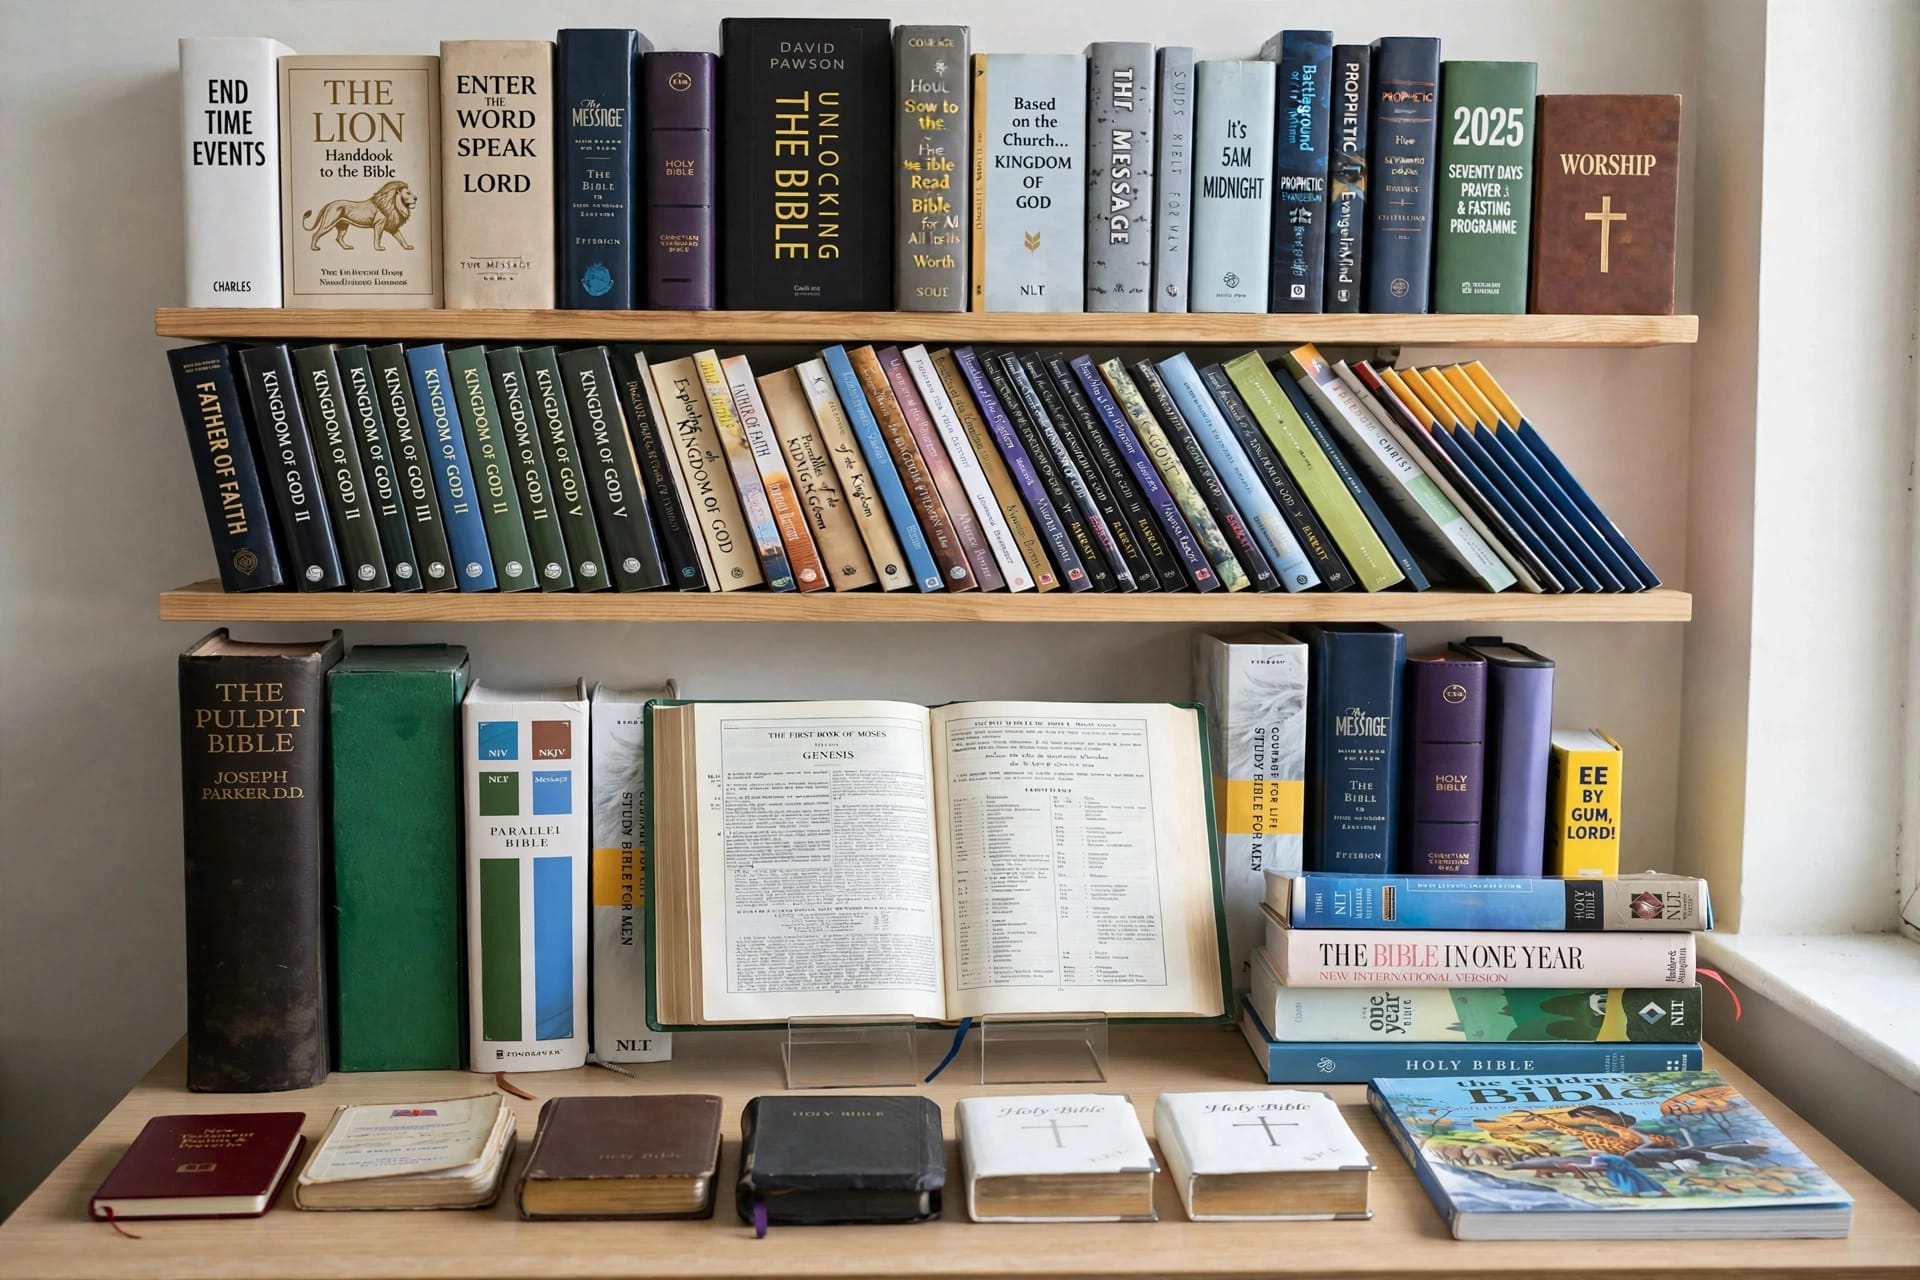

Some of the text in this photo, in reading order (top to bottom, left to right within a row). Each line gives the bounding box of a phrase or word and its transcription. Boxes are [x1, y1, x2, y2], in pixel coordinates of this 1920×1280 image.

[781, 42, 835, 54] DAVID
[770, 58, 845, 70] PAWSON
[208, 79, 248, 104] END
[323, 79, 394, 105] THE
[456, 75, 537, 96] ENTER
[484, 97, 506, 107] THE
[905, 99, 959, 113] Sow to
[1014, 97, 1056, 111] Based
[205, 110, 253, 135] TIME
[312, 112, 406, 143] LION
[456, 109, 536, 130] WORD
[775, 91, 809, 157] THE
[1012, 114, 1058, 128] on the
[1453, 106, 1524, 147] 2025
[1227, 120, 1247, 139] It's
[456, 138, 537, 158] SPEAK
[1003, 133, 1069, 147] Church...
[193, 141, 266, 166] EVENTS
[994, 156, 1072, 169] KINGDOM
[1221, 147, 1251, 167] 5AM
[320, 165, 396, 178] to the Bible
[665, 160, 695, 168] HOLY
[666, 168, 695, 176] BIBLE
[1449, 165, 1523, 180] SEVENTY DAYS
[1560, 154, 1656, 176] WORSHIP
[463, 173, 531, 193] LORD
[586, 170, 611, 179] THE
[818, 92, 840, 259] UNLOCKING
[911, 174, 950, 190] Read
[1022, 176, 1044, 189] OF
[1281, 176, 1323, 191] PROPHETIC
[1109, 129, 1133, 245] MESSAGE
[1203, 177, 1265, 199] MIDNIGHT
[1461, 183, 1501, 198] PRAYER
[912, 196, 952, 213] Bible
[1016, 196, 1052, 209] GOD
[1457, 201, 1511, 216] & FASTING
[775, 170, 809, 259] BIBLE
[1450, 219, 1517, 234] PROGRAMME
[913, 254, 955, 268] Worth
[213, 281, 252, 293] CHARLES
[1020, 285, 1045, 296] NLT
[196, 381, 230, 453] FATHER
[262, 370, 311, 523] KINGDOM OF GOD II
[312, 369, 360, 521] KINGDOM OF GOD II
[350, 367, 398, 517] KINGDOM OF GOD II
[384, 367, 433, 523] KINGDOM OF GOD III
[424, 368, 469, 515] KINGDOM OF GOD II
[464, 368, 509, 515] KINGDOM OF GOD II
[502, 371, 549, 521] KINGDOM OF GOD II
[536, 369, 584, 517] KINGDOM OF GOD V
[580, 370, 628, 518] KINGDOM OF GOD V
[213, 454, 236, 477] OF
[677, 419, 734, 555] KINGDOM OF GOD
[219, 483, 248, 536] FAITH
[215, 682, 284, 703] THE
[195, 708, 306, 729] PULPIT
[207, 733, 294, 753] BIBLE
[789, 731, 814, 739] FIRST
[857, 730, 887, 738] MOSES
[488, 748, 566, 758] NIV NKJV
[802, 751, 855, 760] GENESIS
[214, 770, 288, 785] JOSEPH
[1349, 780, 1374, 790] THE
[1435, 774, 1467, 783] HOLY
[1579, 766, 1609, 785] EE
[202, 788, 272, 800] PARKER
[1270, 783, 1279, 809] FOR
[1435, 783, 1467, 792] BIBLE
[1582, 790, 1604, 803] BY
[1250, 727, 1266, 872] STUDY BIBLE FOR MEN
[1344, 793, 1377, 803] BIBLE
[1571, 808, 1613, 824] GUM,
[490, 826, 561, 836] PARALLEL
[1567, 826, 1615, 840] LORD!
[505, 838, 549, 848] BIBLE
[621, 792, 633, 946] STUDY BIBLE FOR MEN
[1574, 890, 1584, 920] HOLY
[1666, 891, 1681, 921] NLT
[1319, 943, 1585, 970] THE BIBLE IN ONE YEAR
[1319, 972, 1508, 983] NEW INTERNATIONAL VERSION
[1370, 996, 1384, 1031] one
[1385, 992, 1406, 1034] year
[1671, 1000, 1684, 1026] NLT
[615, 1039, 652, 1052] NLT
[1406, 1060, 1535, 1071] HOLY BIBLE
[997, 1105, 1105, 1117] Holy Bible
[1203, 1103, 1311, 1114] Holy Bible
